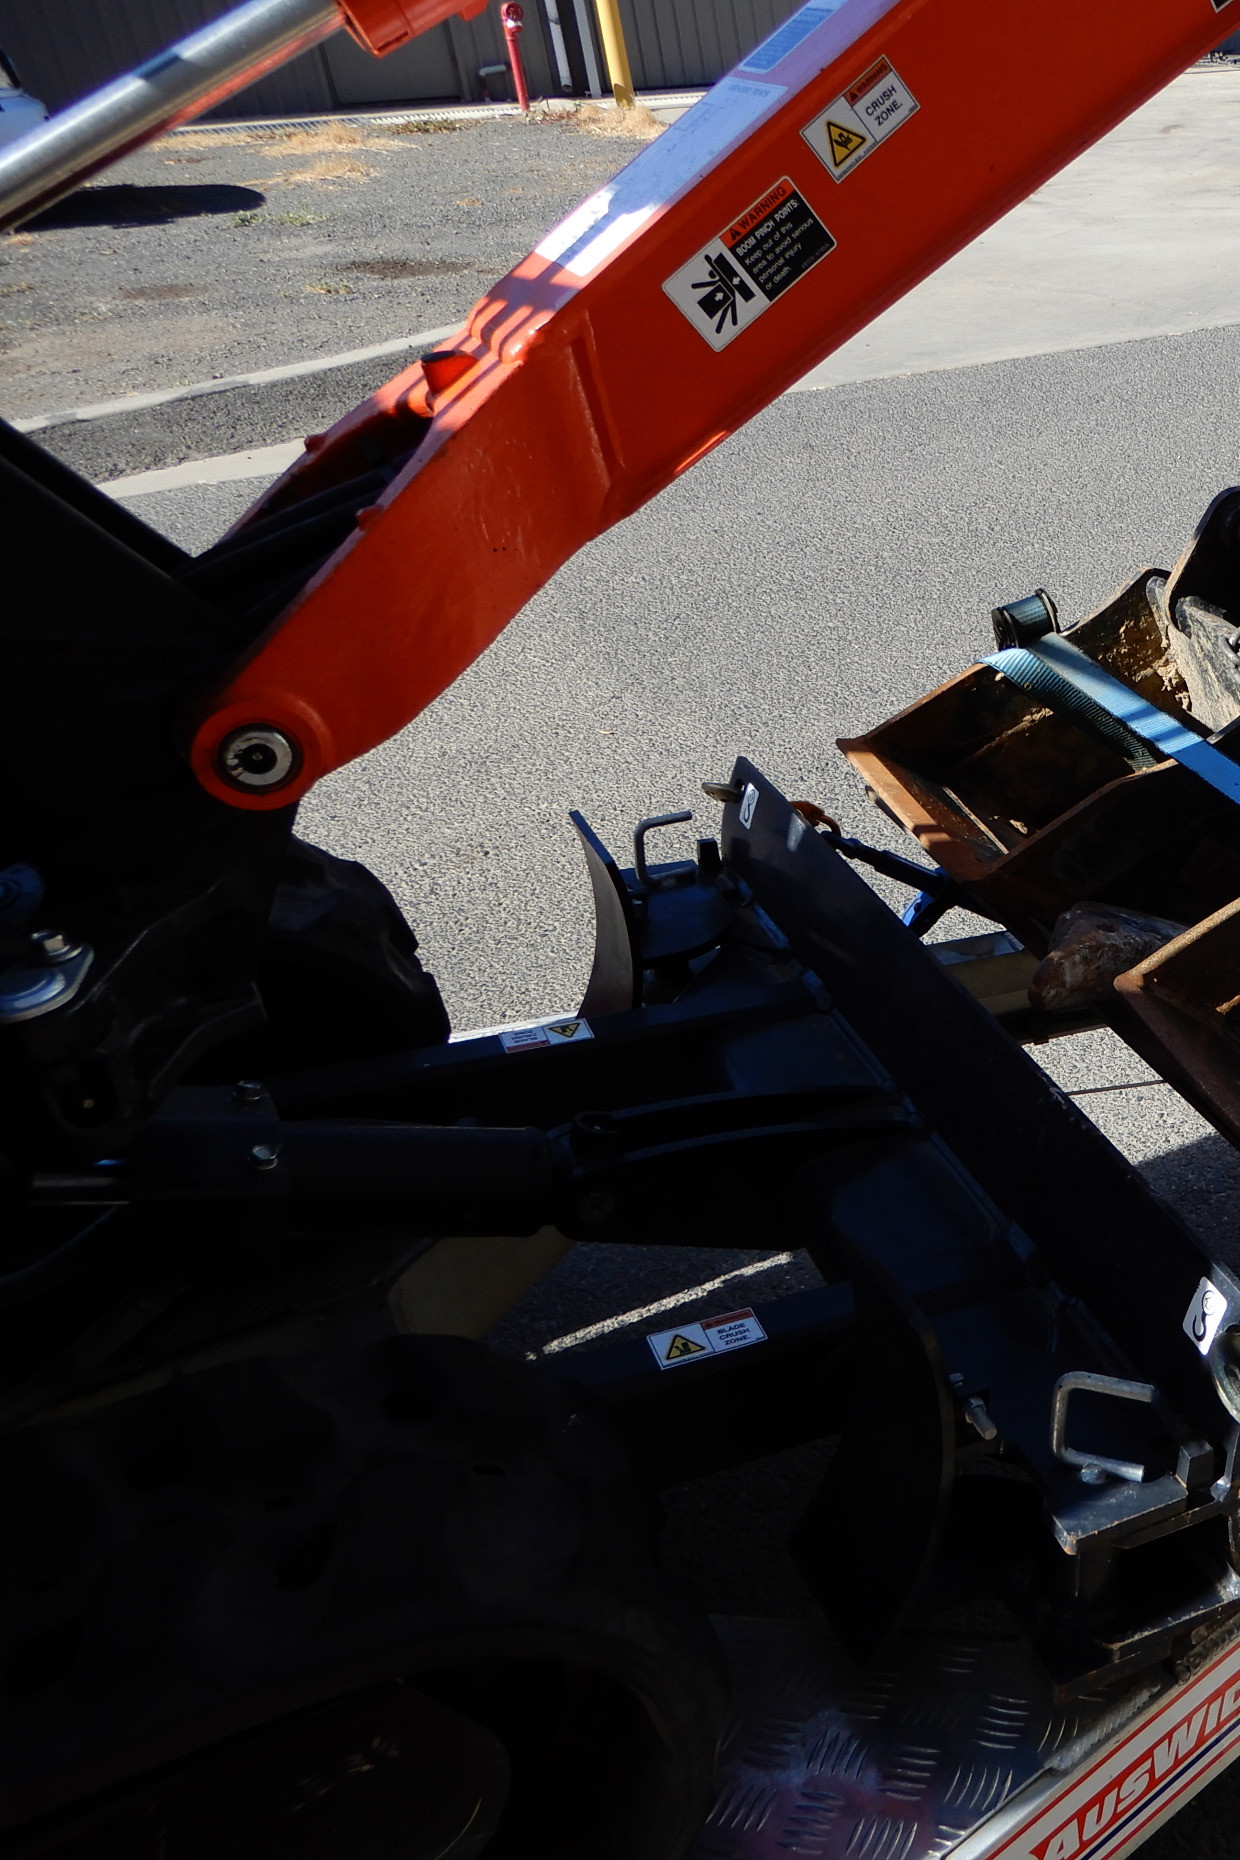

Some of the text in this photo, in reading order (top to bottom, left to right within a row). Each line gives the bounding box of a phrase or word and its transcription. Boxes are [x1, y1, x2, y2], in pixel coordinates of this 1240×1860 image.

[856, 63, 888, 94] WARNING
[865, 85, 897, 117] CRUSH
[874, 99, 903, 127] ZONE.
[739, 186, 787, 230] WARNING
[735, 236, 757, 257] BOOM
[754, 220, 776, 240] PINCH
[744, 222, 794, 266] Keep out of this
[752, 217, 814, 274] area to avoid serious
[758, 257, 785, 283] personal
[784, 241, 802, 260] injury
[765, 282, 773, 290] or
[716, 1322, 747, 1335] BLADE
[718, 1328, 751, 1341] CRUSH
